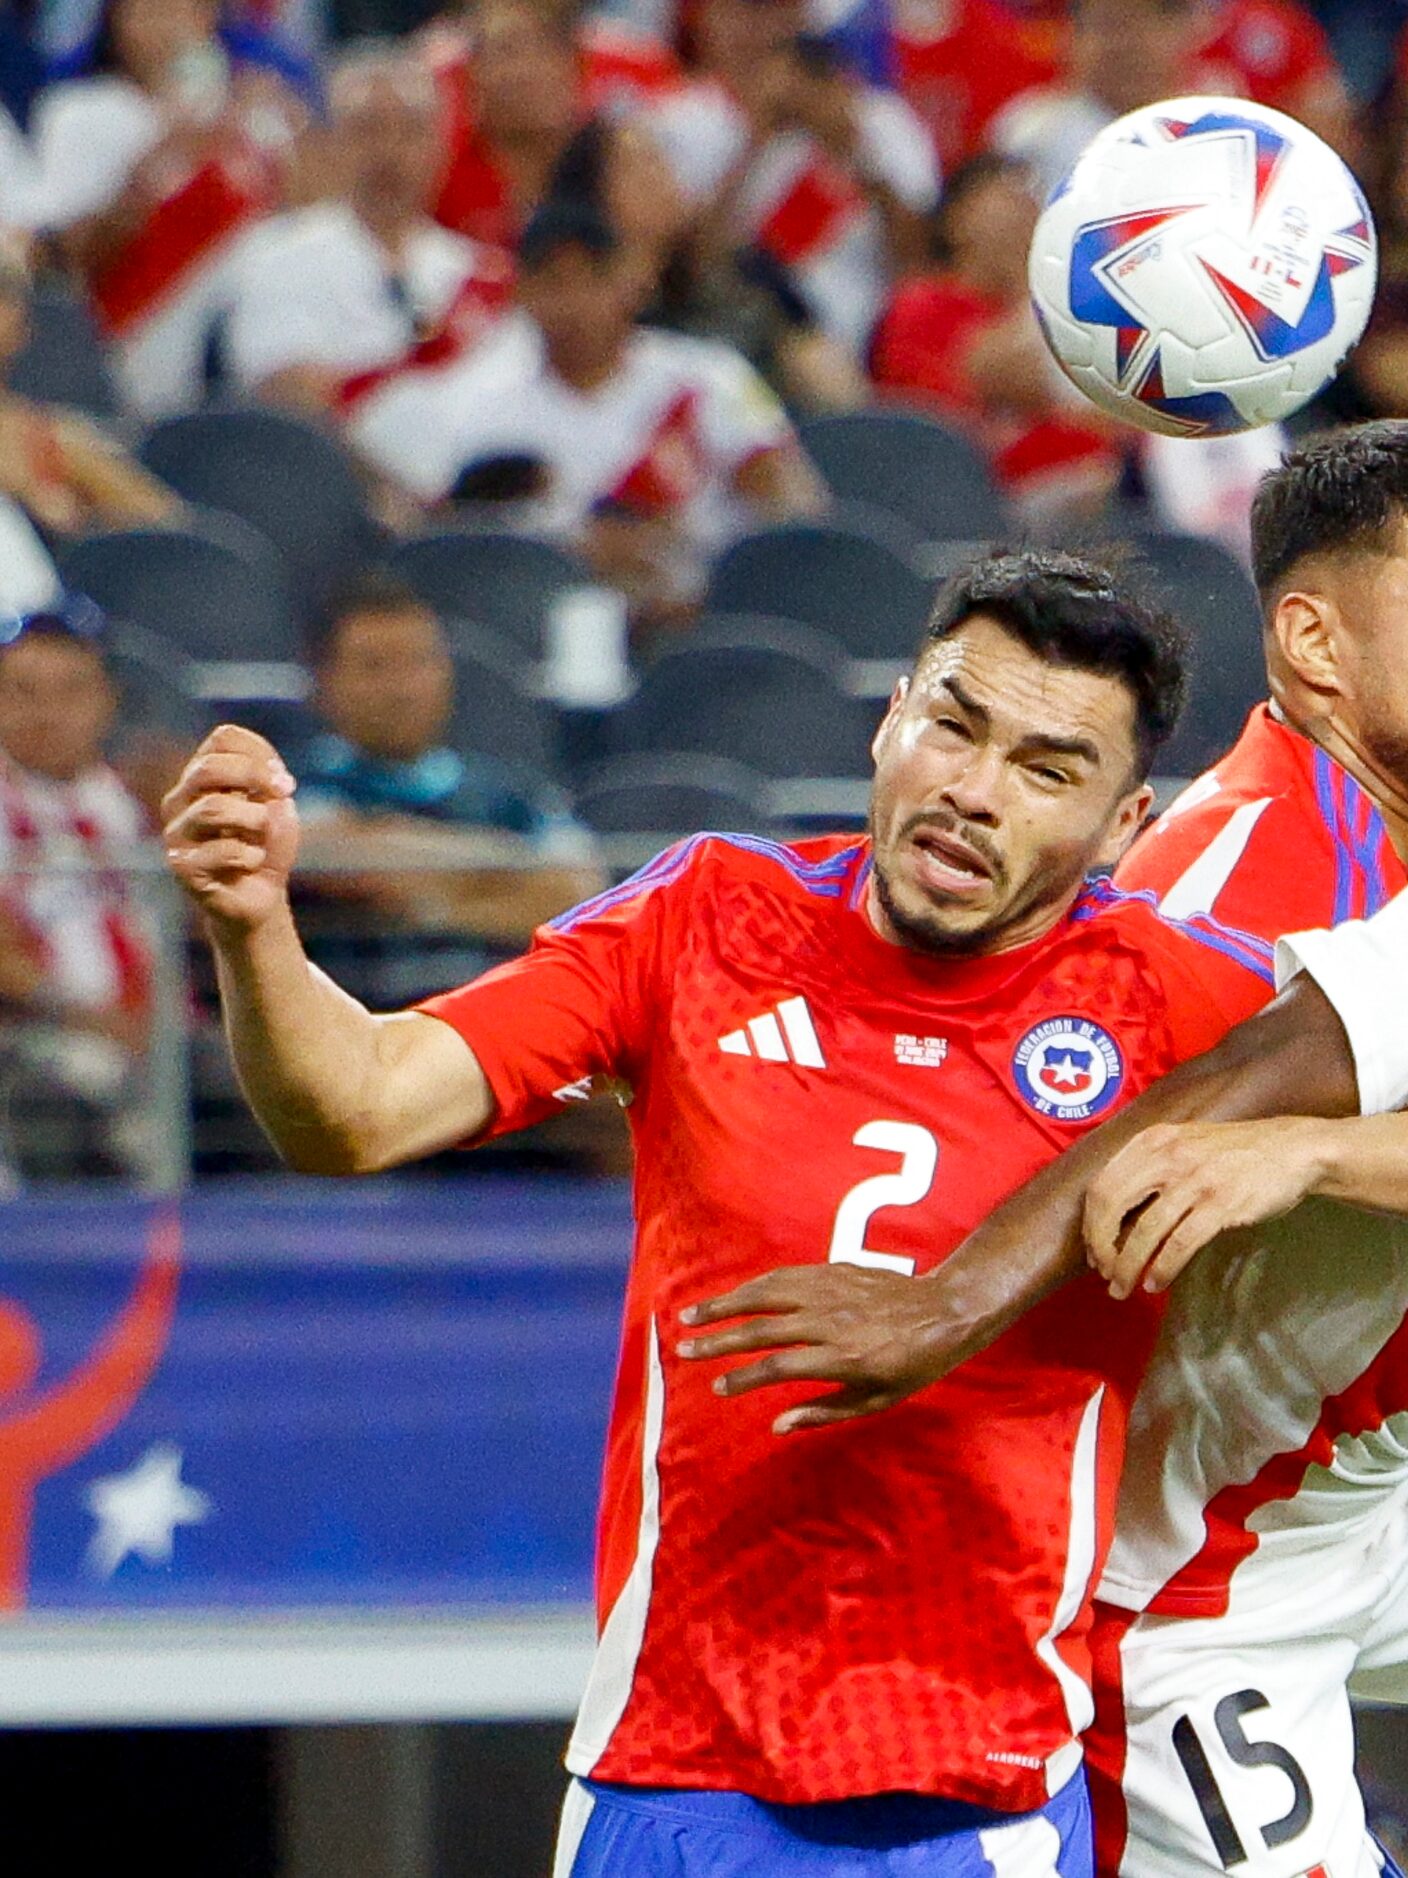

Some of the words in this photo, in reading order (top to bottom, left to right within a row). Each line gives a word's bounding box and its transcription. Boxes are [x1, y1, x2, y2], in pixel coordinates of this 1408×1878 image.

[1079, 1020, 1098, 1039] DE
[1057, 1104, 1092, 1119] CHILE
[829, 1119, 939, 1277] 2
[1171, 1688, 1314, 1871] 15
